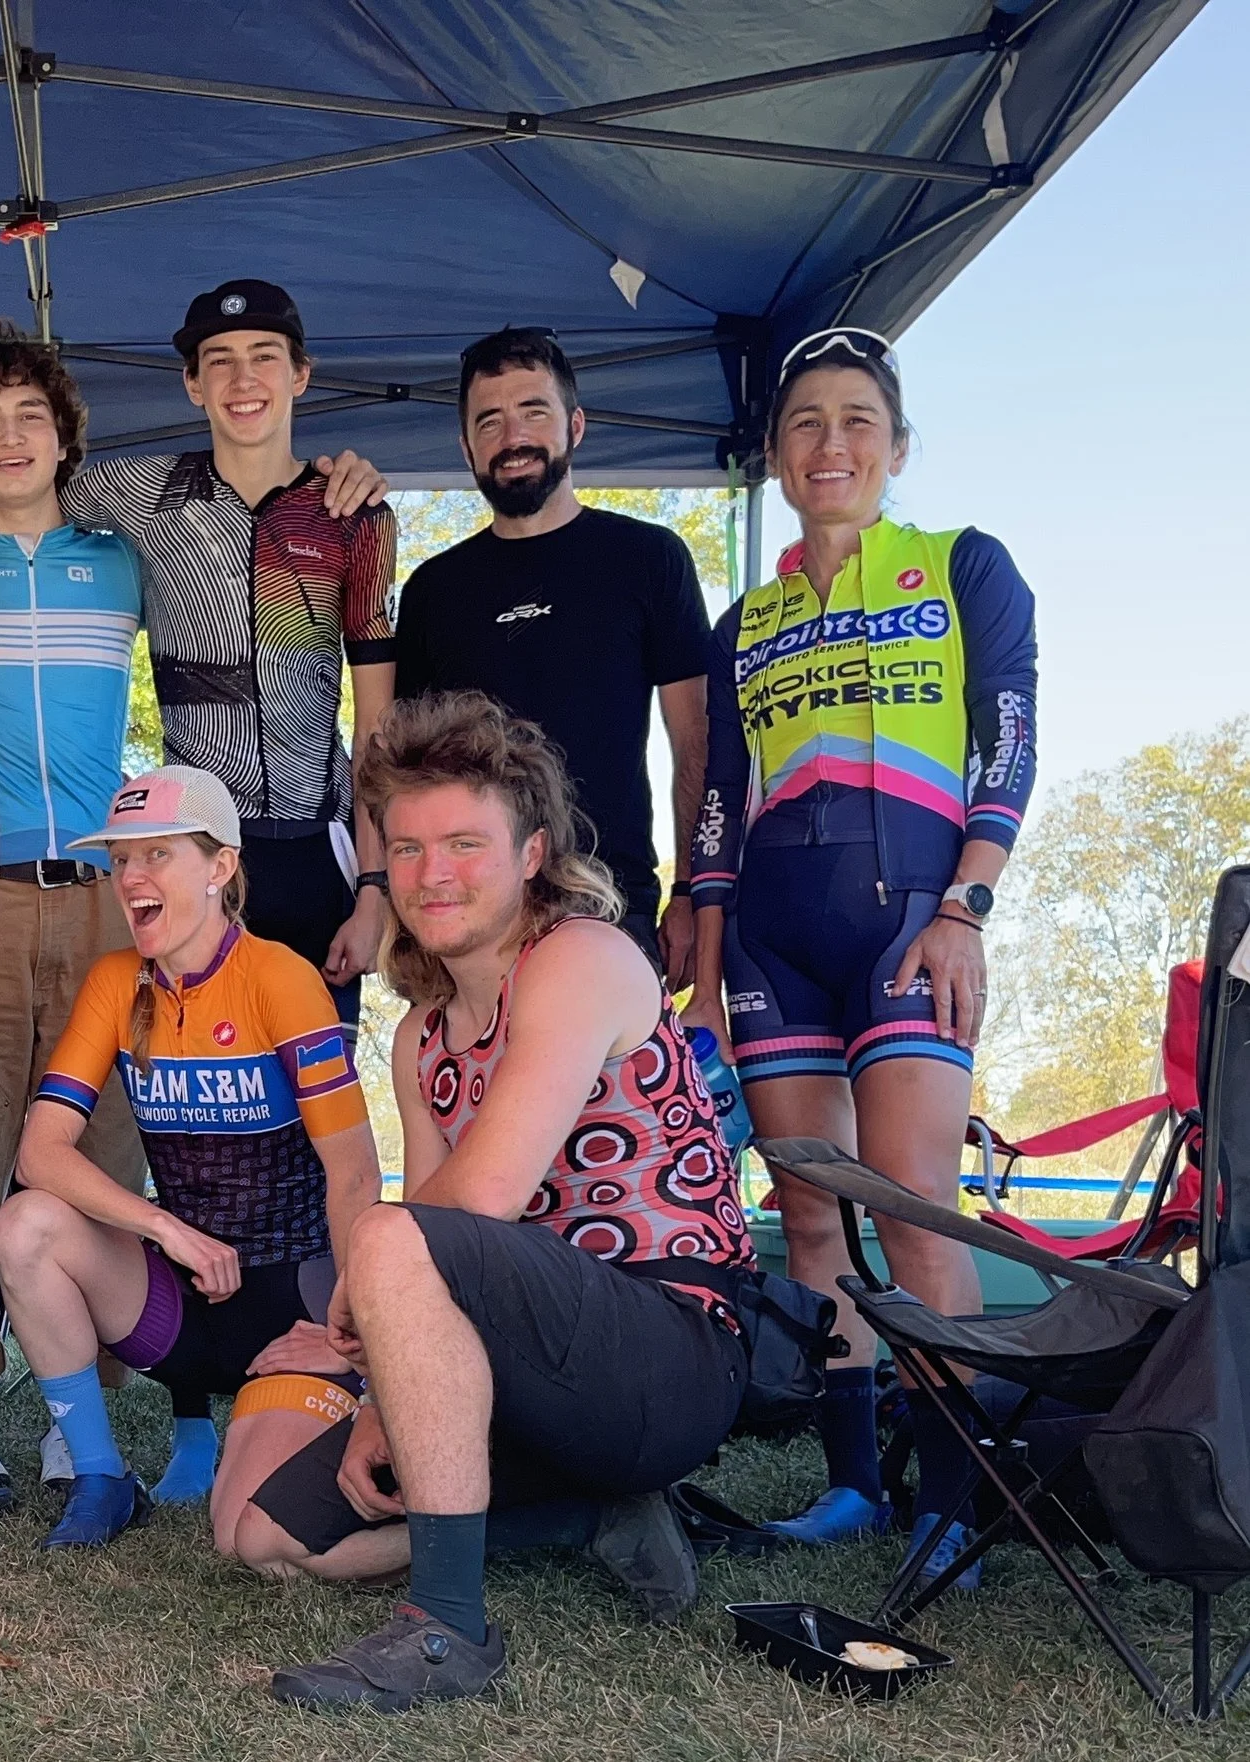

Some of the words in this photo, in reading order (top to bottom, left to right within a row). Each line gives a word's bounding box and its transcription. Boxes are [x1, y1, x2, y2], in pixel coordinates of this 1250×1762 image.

[496, 604, 552, 622] GRX
[778, 651, 810, 667] AUTO
[813, 639, 865, 656] SERVICE
[869, 640, 910, 653] ERVICE
[125, 1063, 187, 1103] TEAM
[195, 1066, 265, 1103] S&M
[181, 1108, 219, 1122] CYCLE
[223, 1104, 271, 1122] REPAIR
